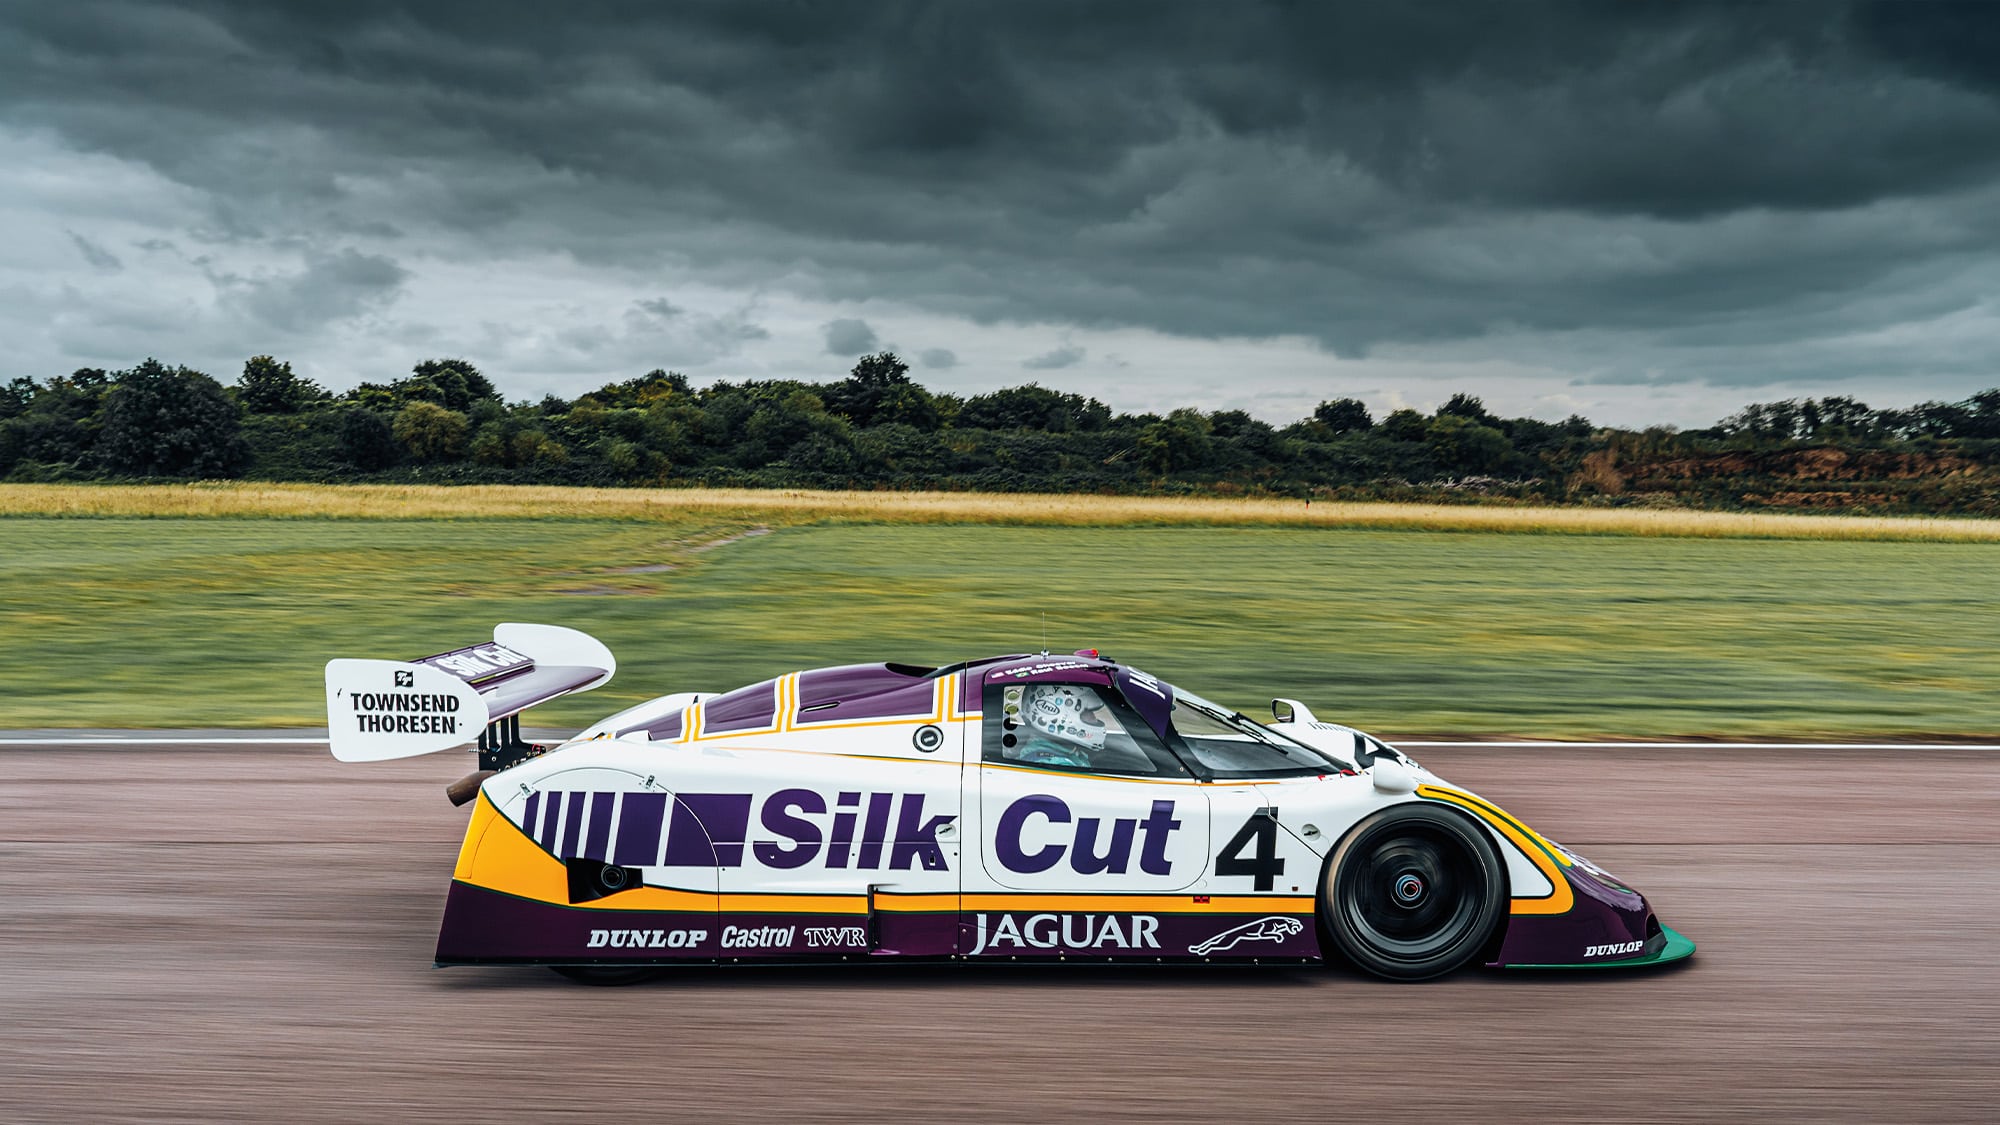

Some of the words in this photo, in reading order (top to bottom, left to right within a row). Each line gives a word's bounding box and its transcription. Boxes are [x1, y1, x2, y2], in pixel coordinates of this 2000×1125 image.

[435, 654, 498, 677] Silk
[472, 645, 529, 667] Cut
[350, 692, 460, 712] TOWNSEND
[1040, 701, 1057, 713] Arai
[357, 714, 456, 734] THORESEN
[752, 788, 957, 872] Silk
[995, 794, 1182, 876] Cut
[1214, 806, 1285, 892] 4
[587, 930, 707, 948] DUNLOP
[721, 925, 795, 949] Castrol
[803, 927, 867, 947] TWR
[970, 913, 1160, 956] JAGUAR
[1584, 940, 1643, 957] DUNLOP
